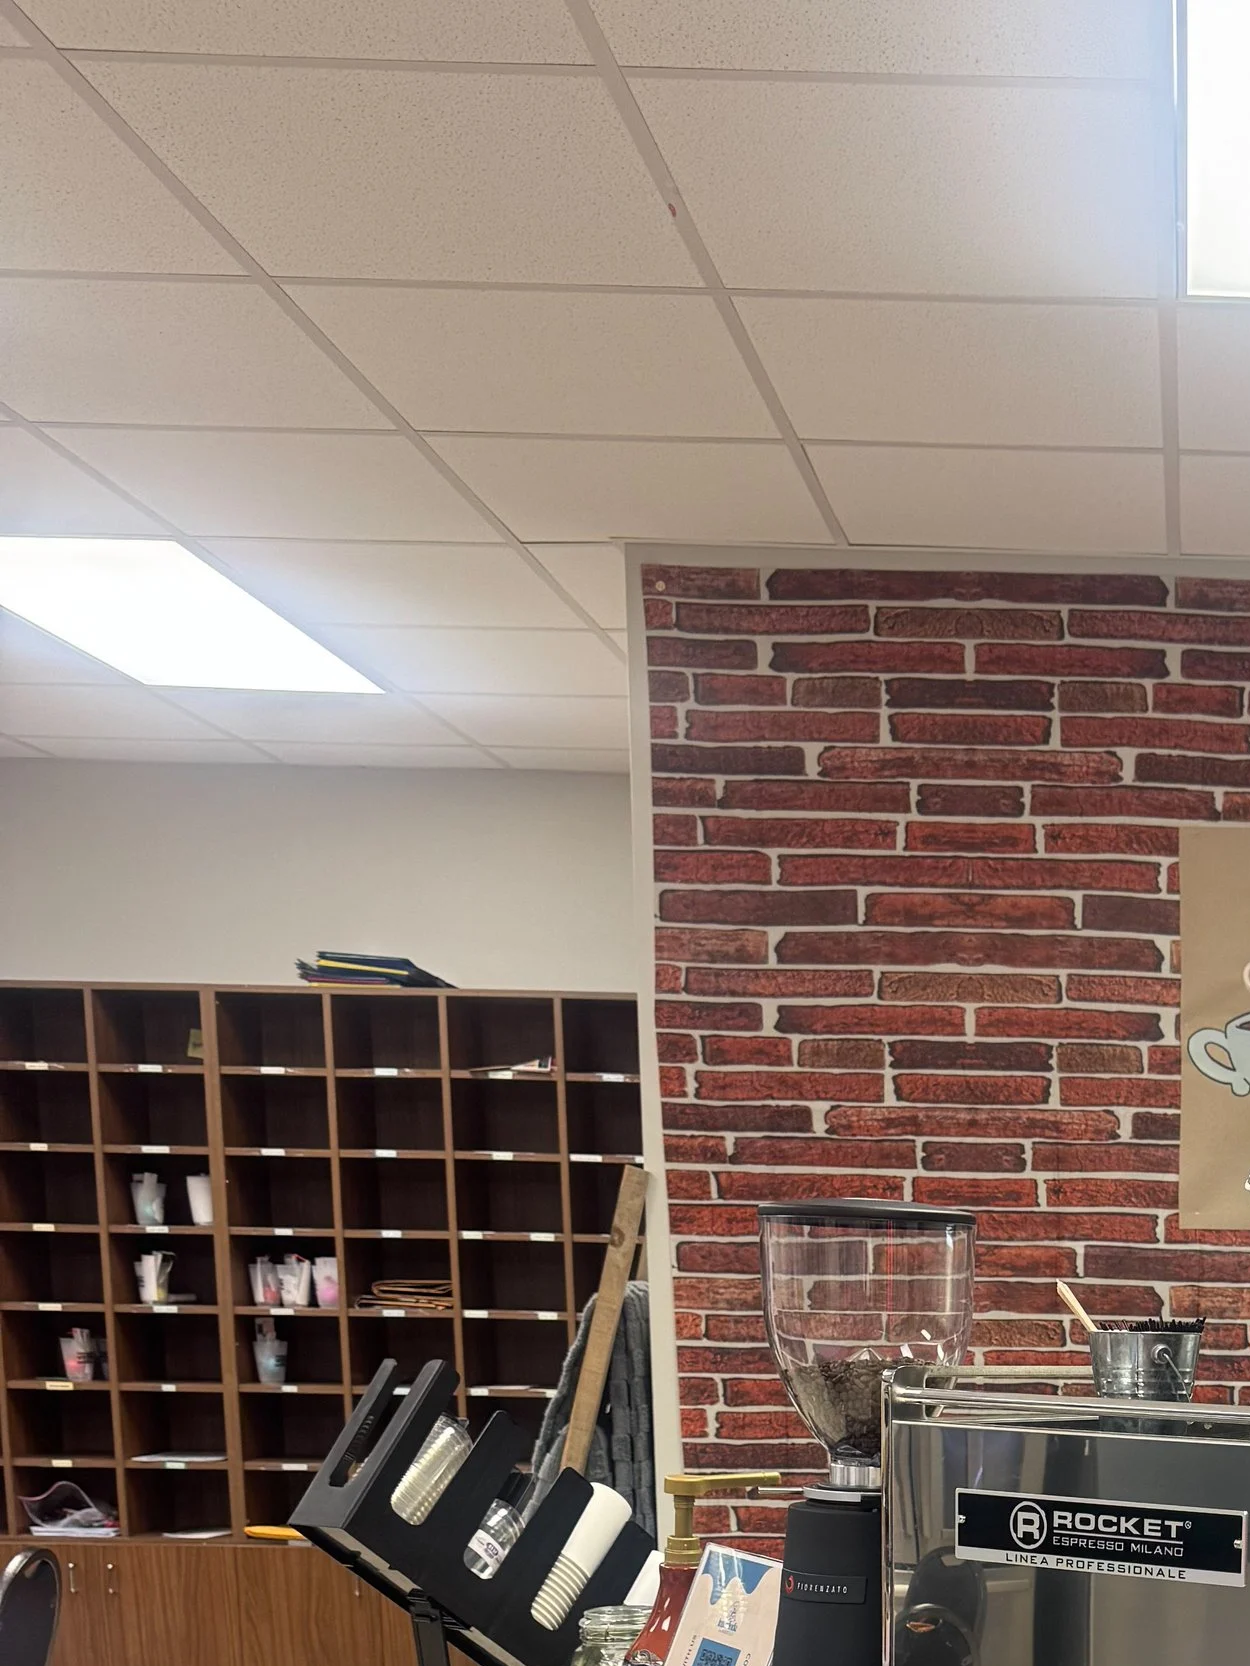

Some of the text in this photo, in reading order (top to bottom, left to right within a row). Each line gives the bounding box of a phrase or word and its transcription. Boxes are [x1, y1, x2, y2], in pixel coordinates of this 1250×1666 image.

[1052, 1535, 1184, 1558] ESPRESSO MILANO
[1005, 1552, 1187, 1581] LINEA PROFESSIONALE
[797, 1581, 848, 1594] FIORENZATO
